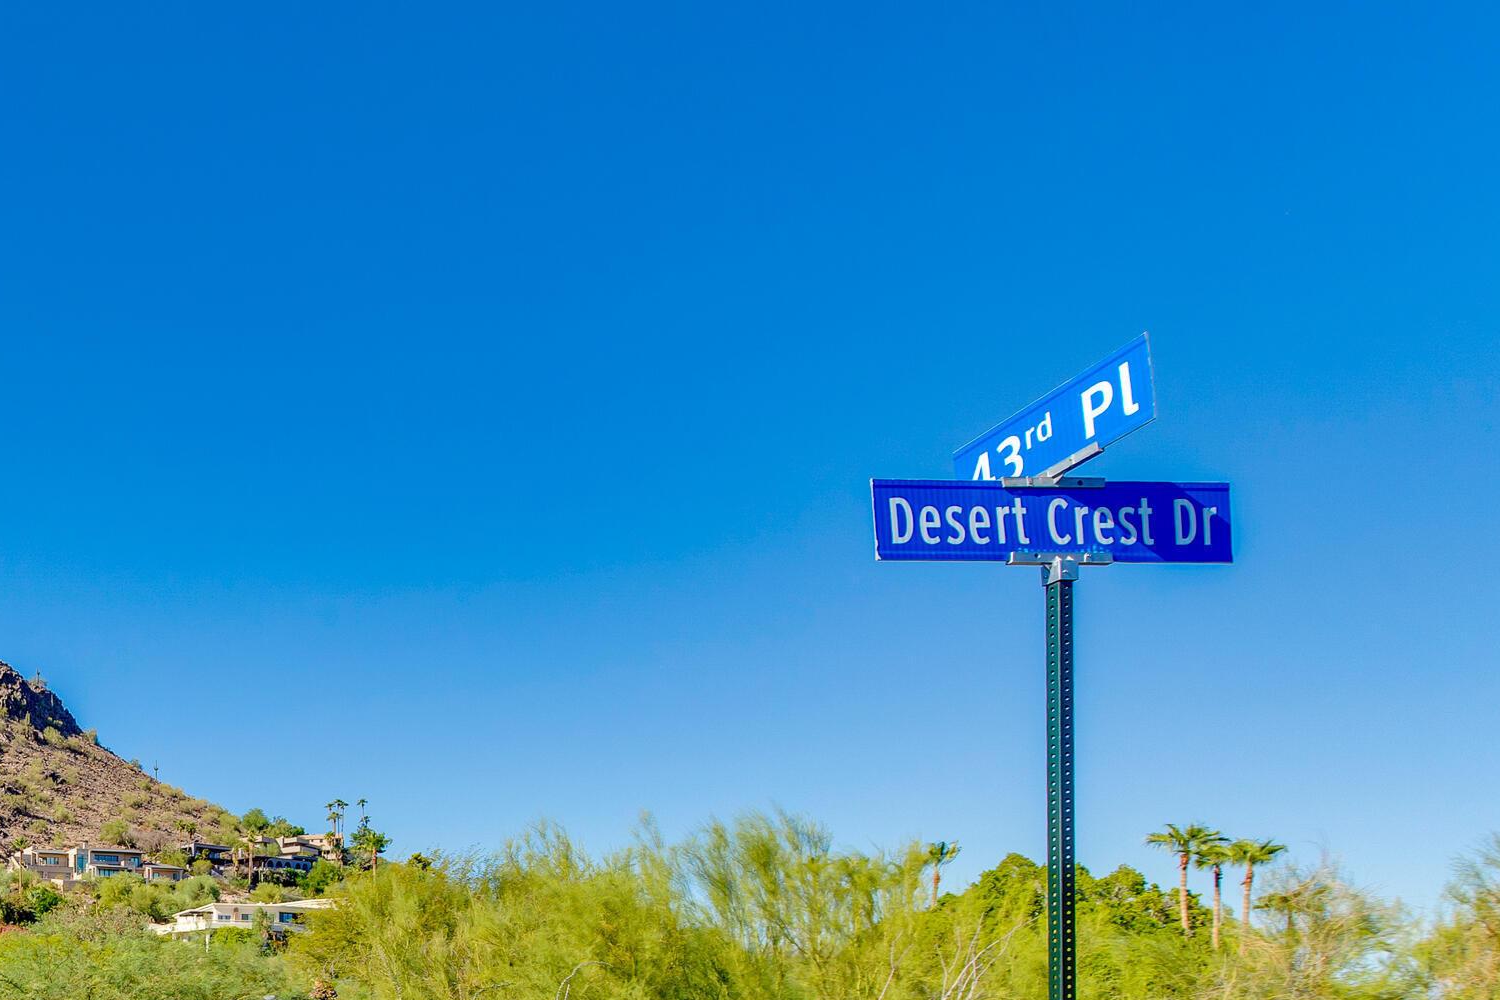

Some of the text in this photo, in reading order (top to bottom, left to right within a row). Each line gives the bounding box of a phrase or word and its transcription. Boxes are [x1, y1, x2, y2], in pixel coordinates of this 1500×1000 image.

[972, 361, 1139, 481] 43rd Pl
[889, 497, 1217, 546] Desert Crest Dr
